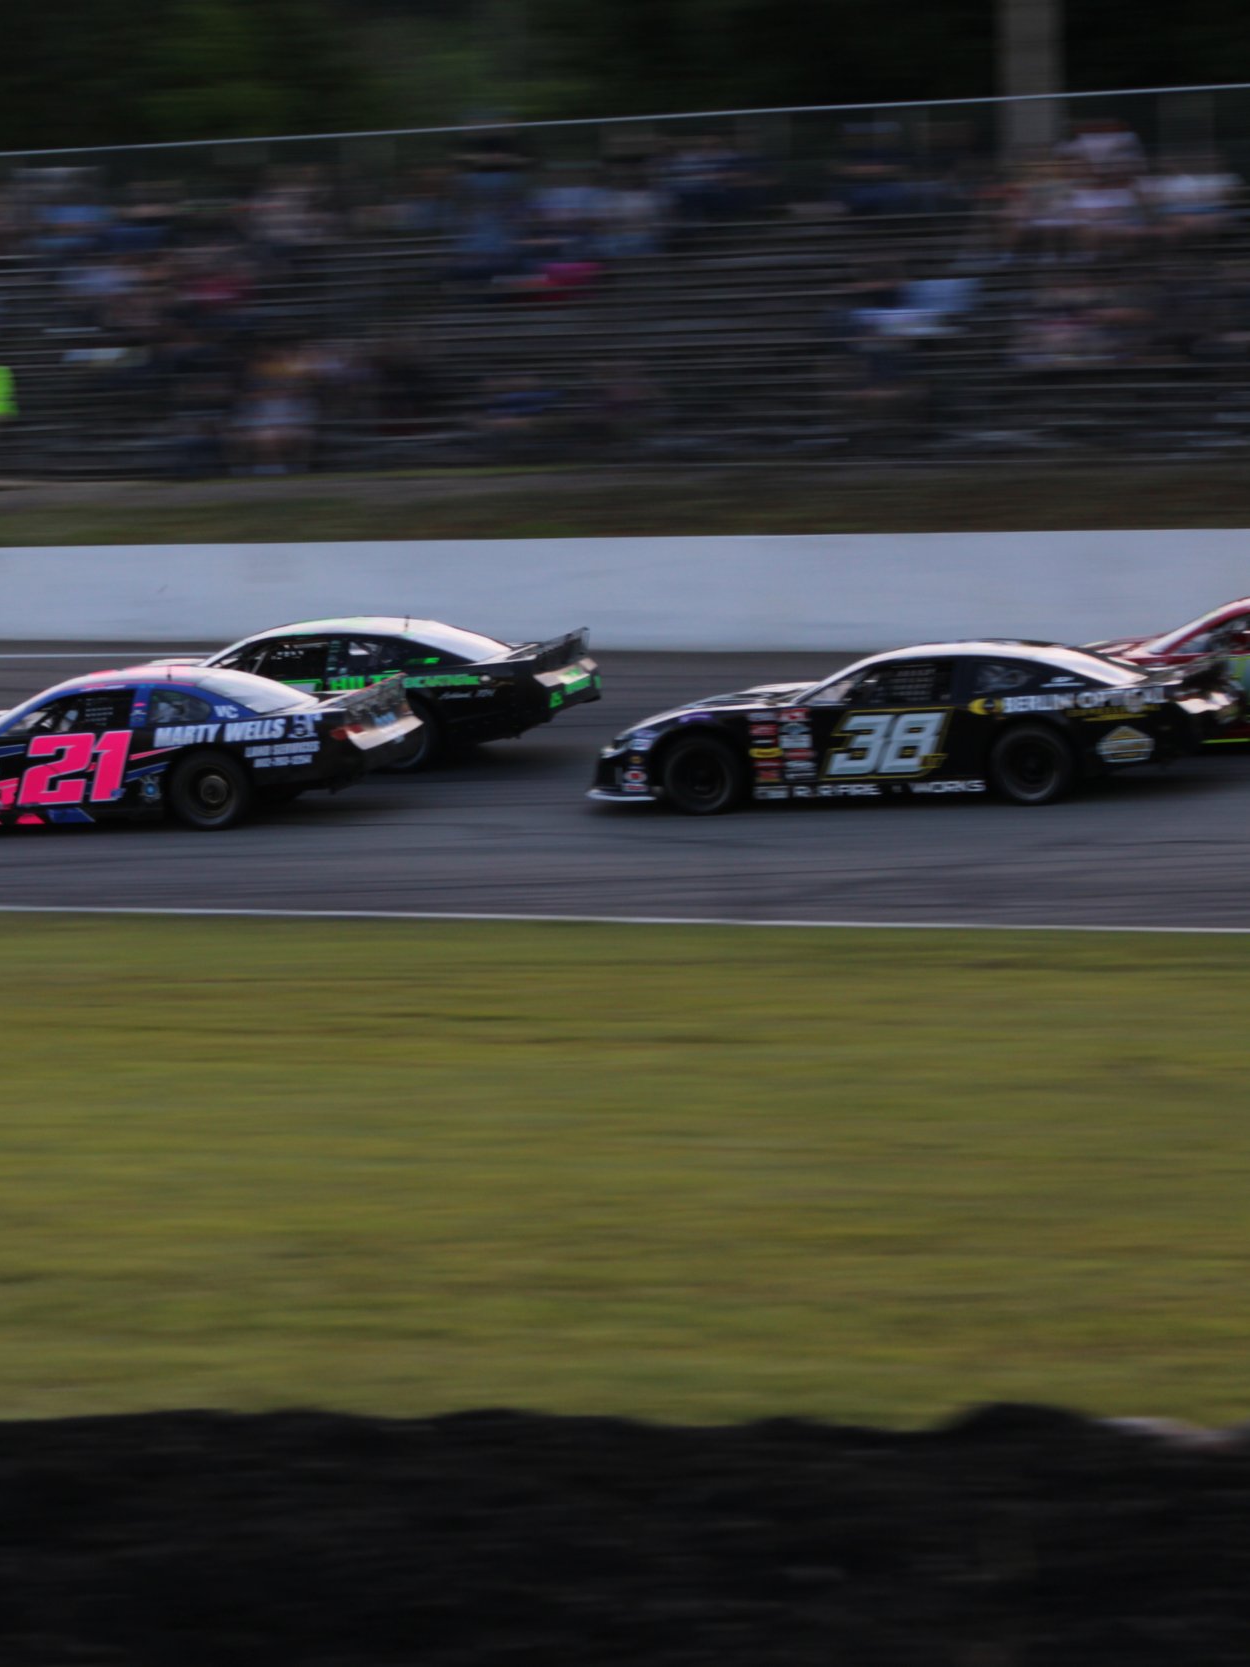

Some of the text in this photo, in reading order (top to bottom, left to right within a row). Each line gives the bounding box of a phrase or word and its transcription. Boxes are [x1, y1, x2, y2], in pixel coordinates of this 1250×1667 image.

[153, 718, 286, 748] MARTY WELLS
[825, 712, 947, 777] 38
[17, 730, 133, 806] 21
